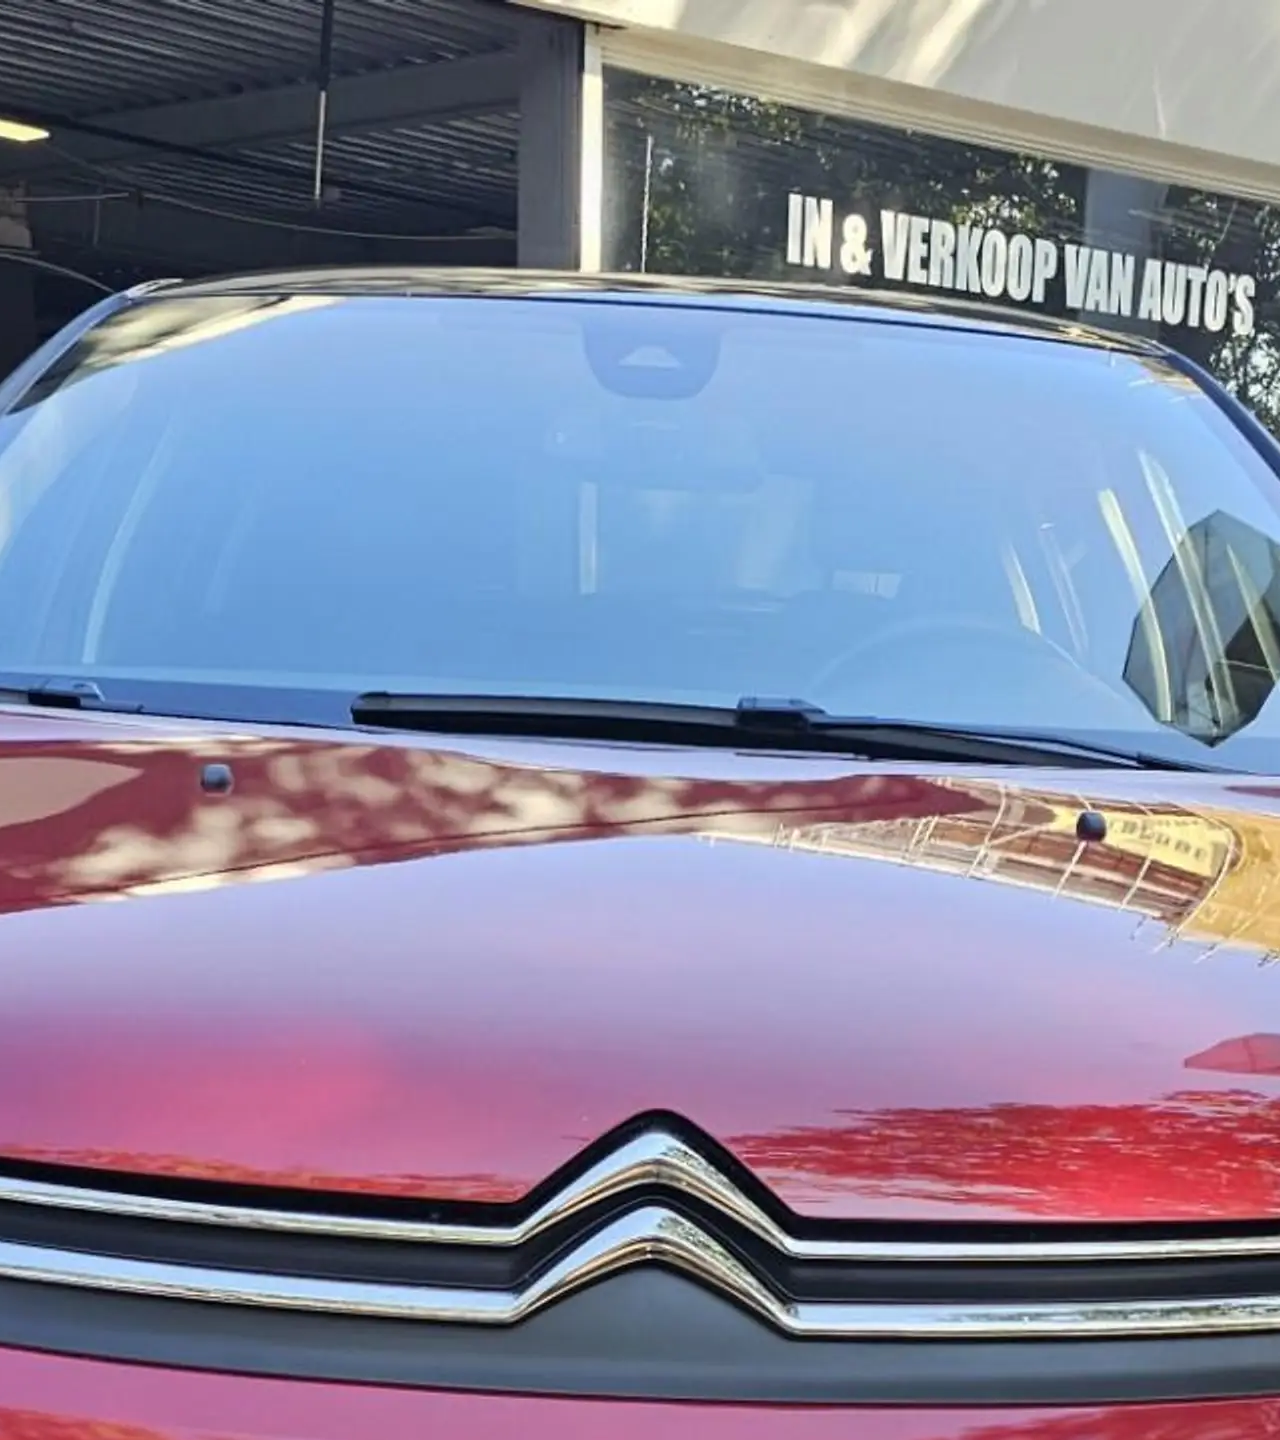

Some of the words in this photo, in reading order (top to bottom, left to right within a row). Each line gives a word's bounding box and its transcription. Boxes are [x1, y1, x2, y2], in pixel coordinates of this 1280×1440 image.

[786, 193, 833, 269] IN
[839, 214, 872, 275] &
[880, 209, 1058, 303] VERKOOP
[1064, 244, 1135, 317] VAN
[1138, 258, 1256, 338] AUTO'S
